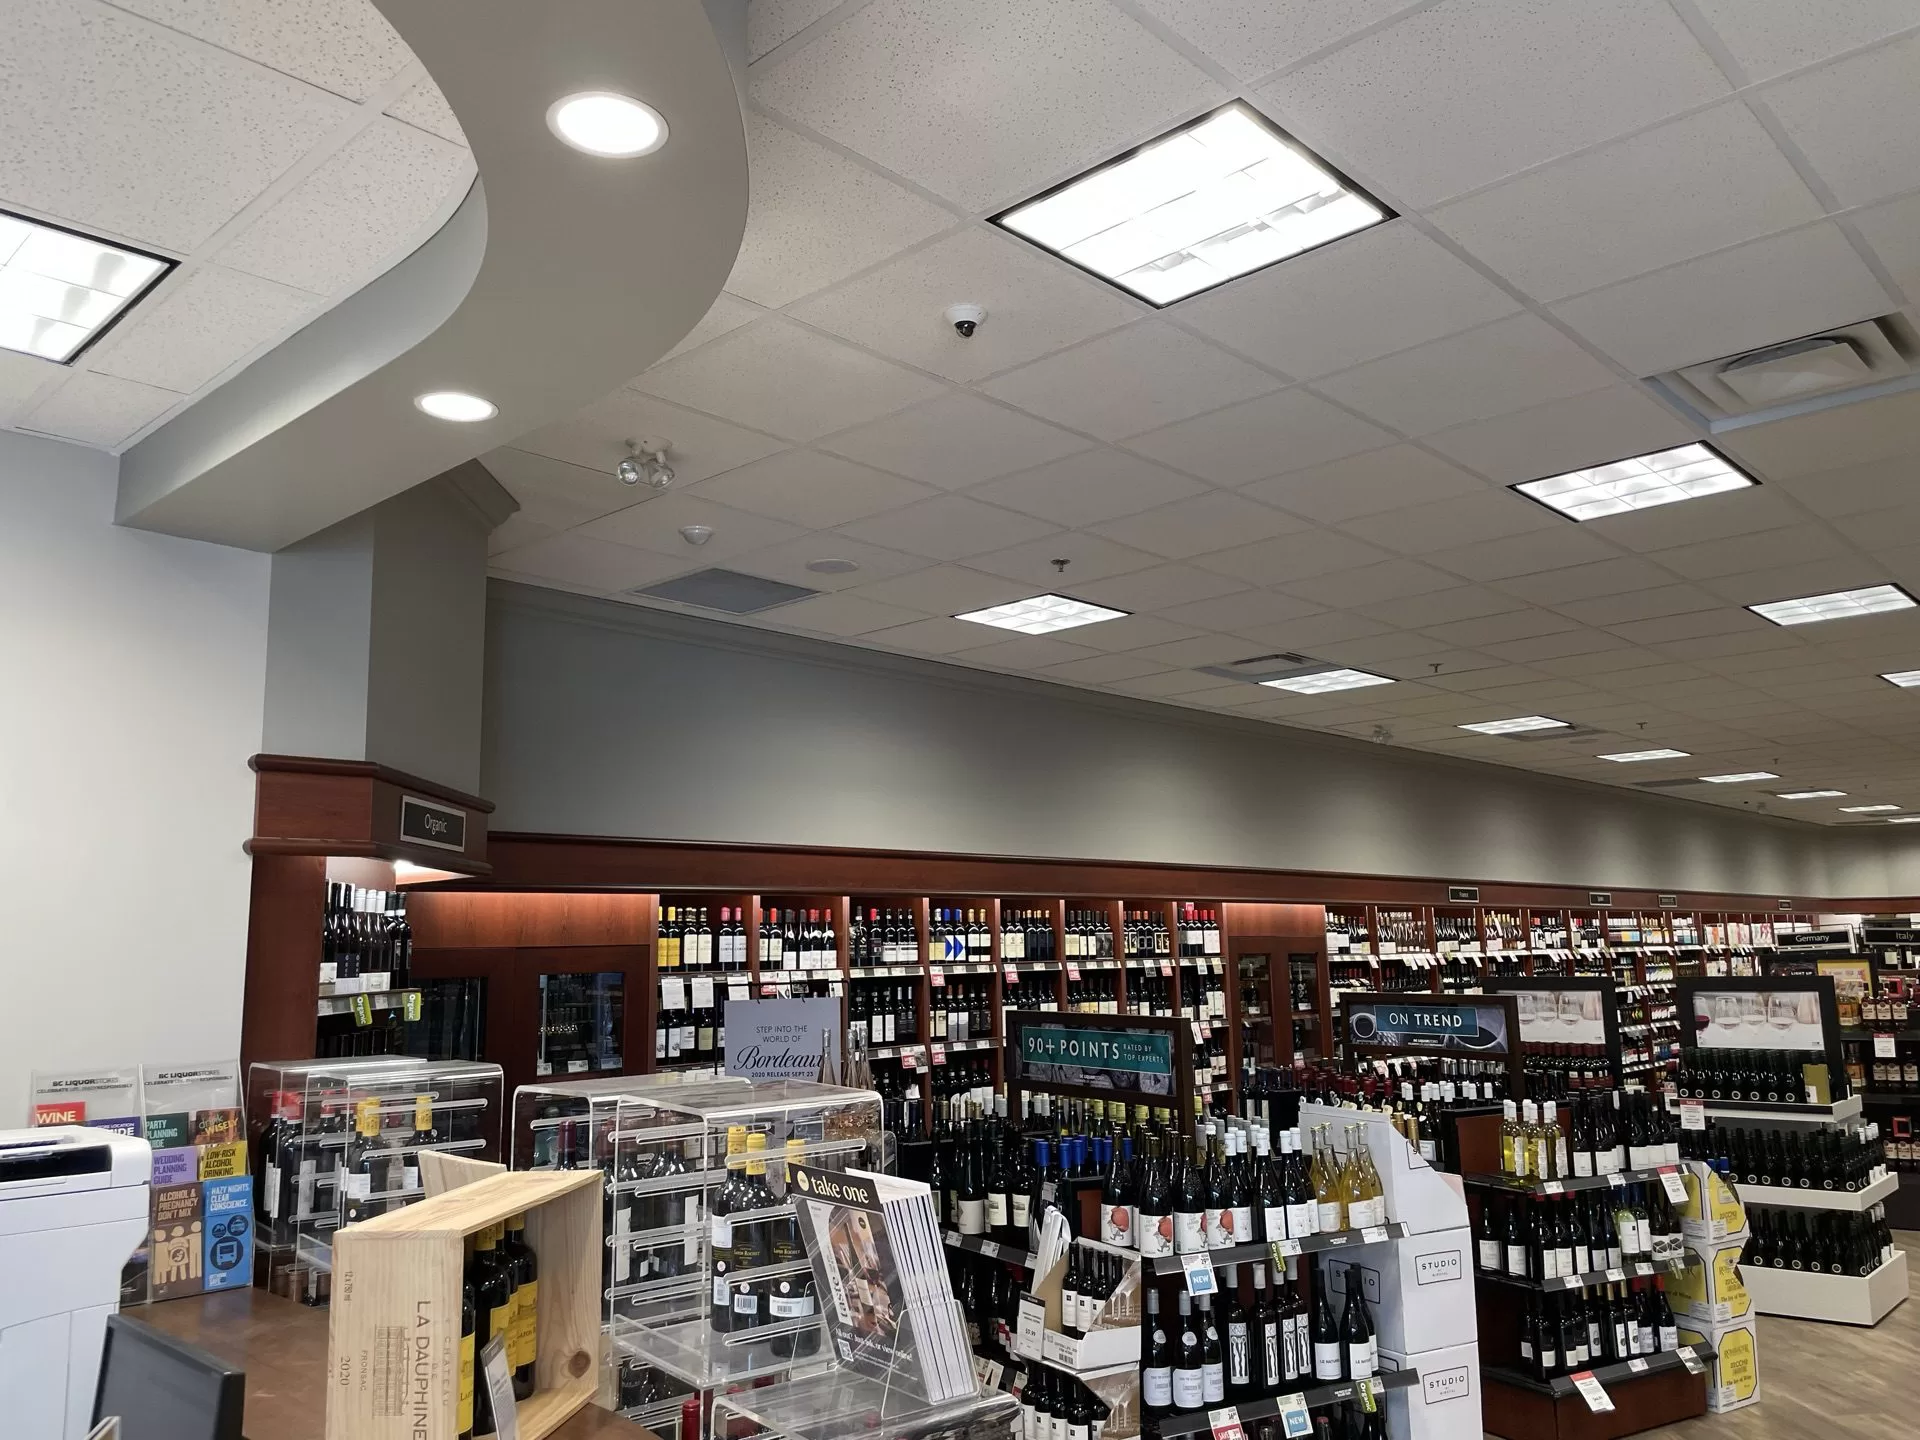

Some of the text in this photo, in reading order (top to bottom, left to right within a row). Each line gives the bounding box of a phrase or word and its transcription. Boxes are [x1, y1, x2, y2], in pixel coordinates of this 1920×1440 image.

[424, 813, 447, 835] Organic
[1796, 934, 1829, 943] Germany
[1896, 932, 1914, 940] Italy
[357, 996, 367, 1025] Organic
[407, 994, 416, 1020] Organic
[1389, 1012, 1462, 1027] ON TREND
[756, 1025, 808, 1034] STEP INTO THE
[763, 1035, 790, 1043] WORLD
[1028, 1037, 1120, 1060] 90+ POINTS
[1123, 1043, 1142, 1052] RATED
[1124, 1053, 1164, 1064] TOP EXPERTS
[36, 1110, 77, 1124] WINE
[146, 1119, 167, 1129] PARTY
[205, 1117, 239, 1136] WISELY
[147, 1128, 178, 1139] PLANNING
[154, 1154, 185, 1165] WEDDING
[206, 1148, 237, 1160] LOW-RISK
[154, 1163, 187, 1175] PLANNING
[204, 1158, 232, 1169] ALCOHOL
[203, 1167, 234, 1178] DRINKING
[154, 1174, 173, 1185] GUIDE
[160, 1188, 197, 1202] ALCOHOL &
[211, 1183, 249, 1195] HAZY NIGHTS
[811, 1176, 869, 1204] take one
[158, 1197, 199, 1210] PREGNANCY
[210, 1193, 229, 1203] CLEAR
[210, 1199, 248, 1212] CONSCIENCE
[157, 1207, 192, 1221] DON'T MIX
[1421, 1258, 1457, 1271] STUDIO
[1193, 1274, 1209, 1284] NEW
[340, 1355, 351, 1386] 2020
[360, 1350, 369, 1392] FRONSAC
[413, 1301, 431, 1440] LA DAUPHINE
[1429, 1375, 1465, 1389] STUDIO
[1360, 1382, 1372, 1412] Organic
[1289, 1415, 1305, 1425] NEW
